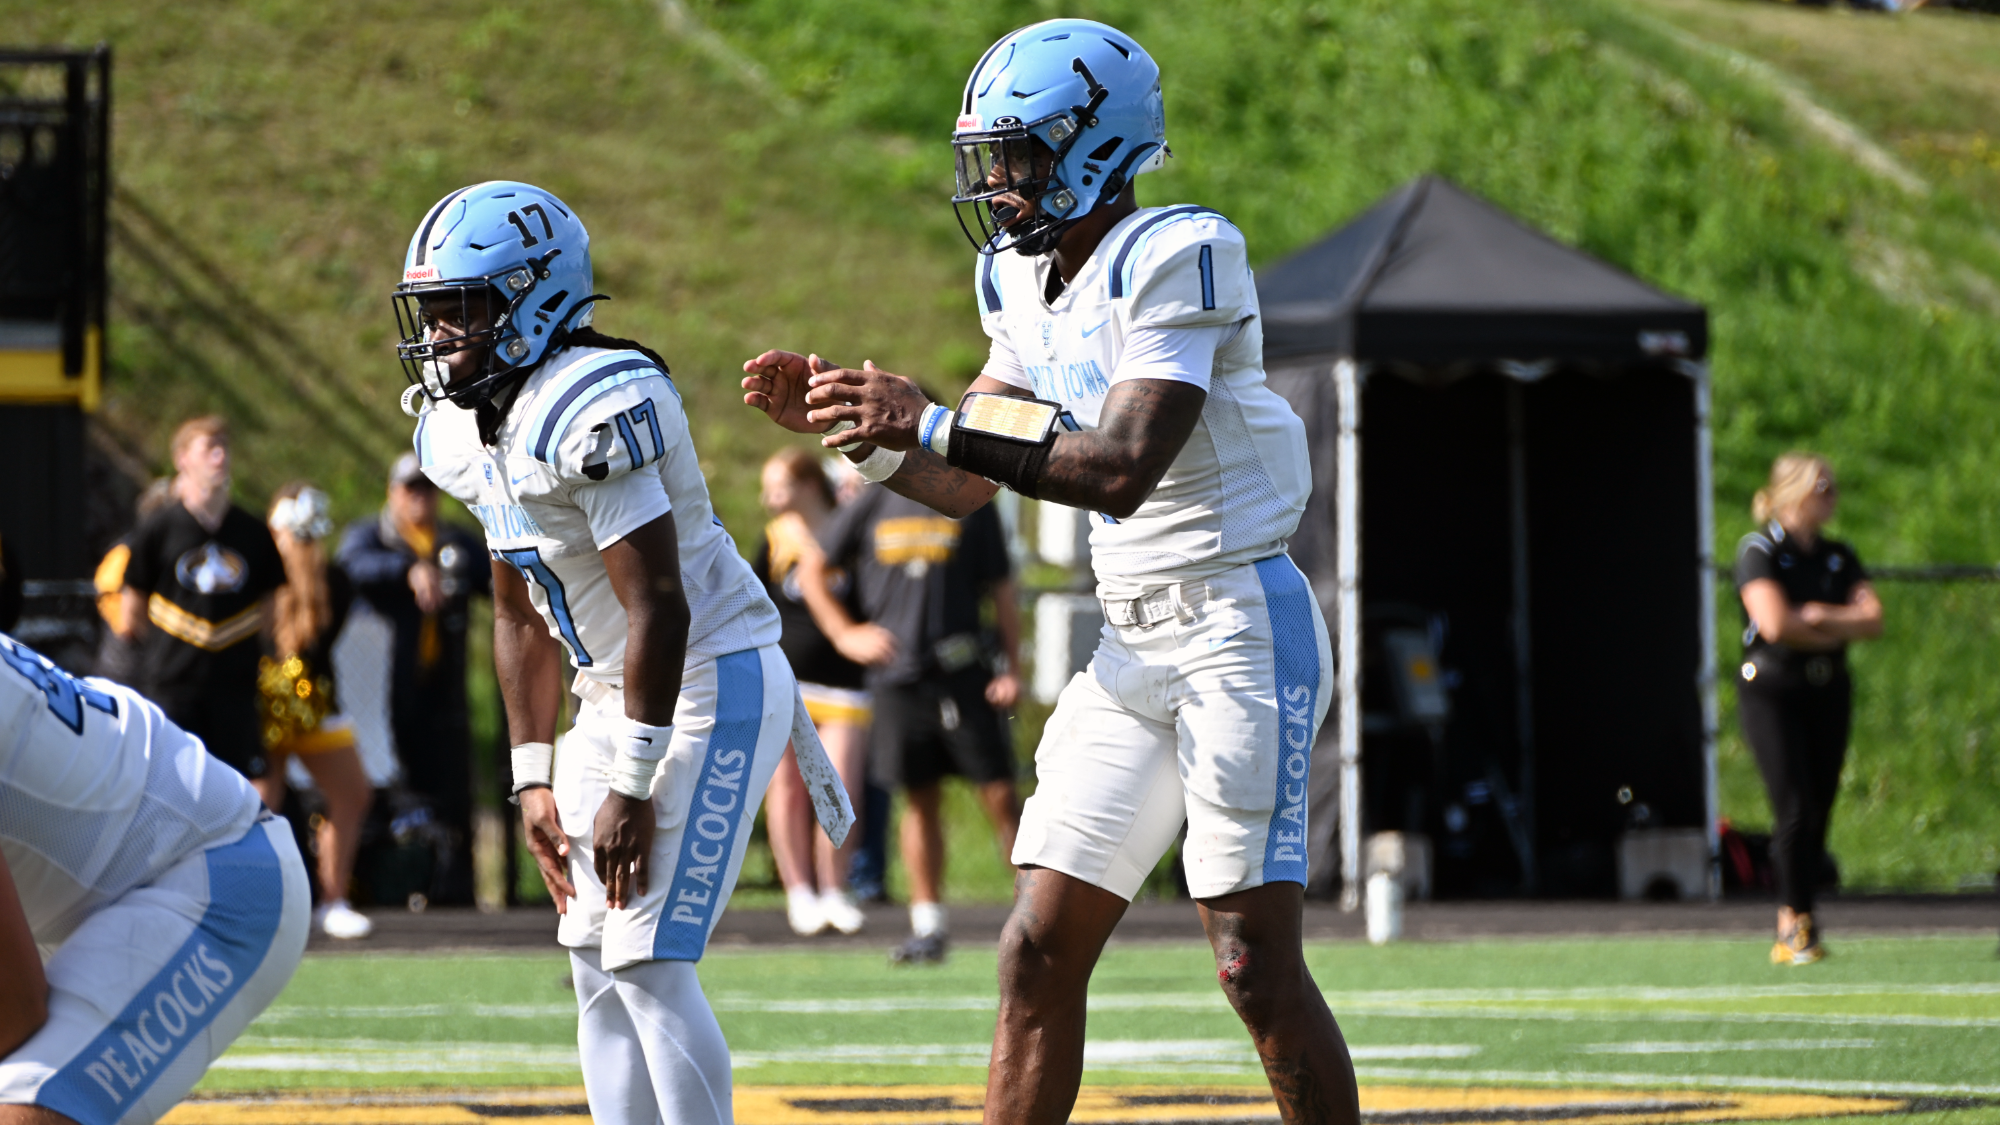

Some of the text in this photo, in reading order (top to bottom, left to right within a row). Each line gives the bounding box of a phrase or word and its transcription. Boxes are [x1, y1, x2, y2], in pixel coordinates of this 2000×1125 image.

[1072, 57, 1104, 100] 1
[508, 202, 554, 249] 17
[406, 268, 434, 280] Riddell
[1198, 244, 1216, 311] 1
[1061, 360, 1110, 401] IOWA
[614, 397, 665, 471] 17
[491, 546, 593, 667] 7
[1274, 684, 1310, 862] PEACOCKS
[669, 749, 746, 926] PEACOCKS
[83, 944, 234, 1105] PEACOCKS
